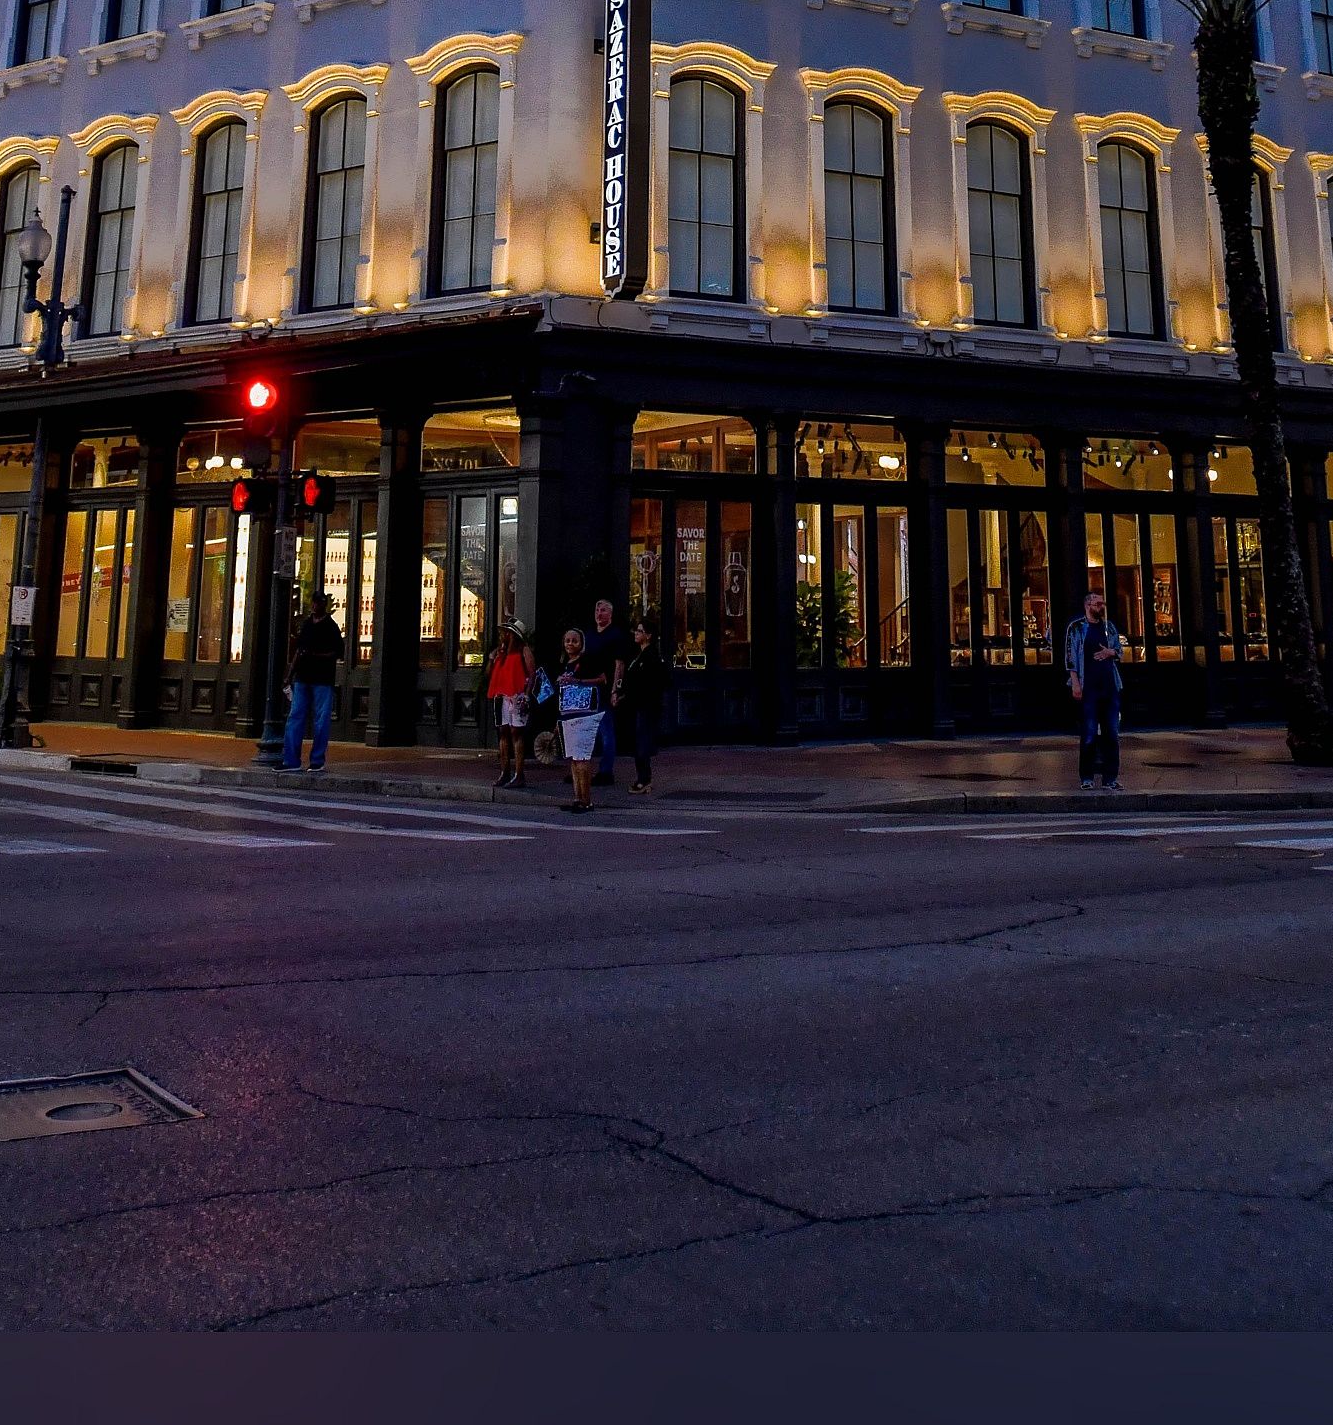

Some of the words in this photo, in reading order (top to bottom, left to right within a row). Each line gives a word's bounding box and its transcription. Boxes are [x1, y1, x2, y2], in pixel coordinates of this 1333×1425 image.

[604, 153, 625, 278] HOUSE
[676, 527, 705, 538] SAVOR
[682, 540, 699, 550] THE
[679, 552, 702, 563] DATE
